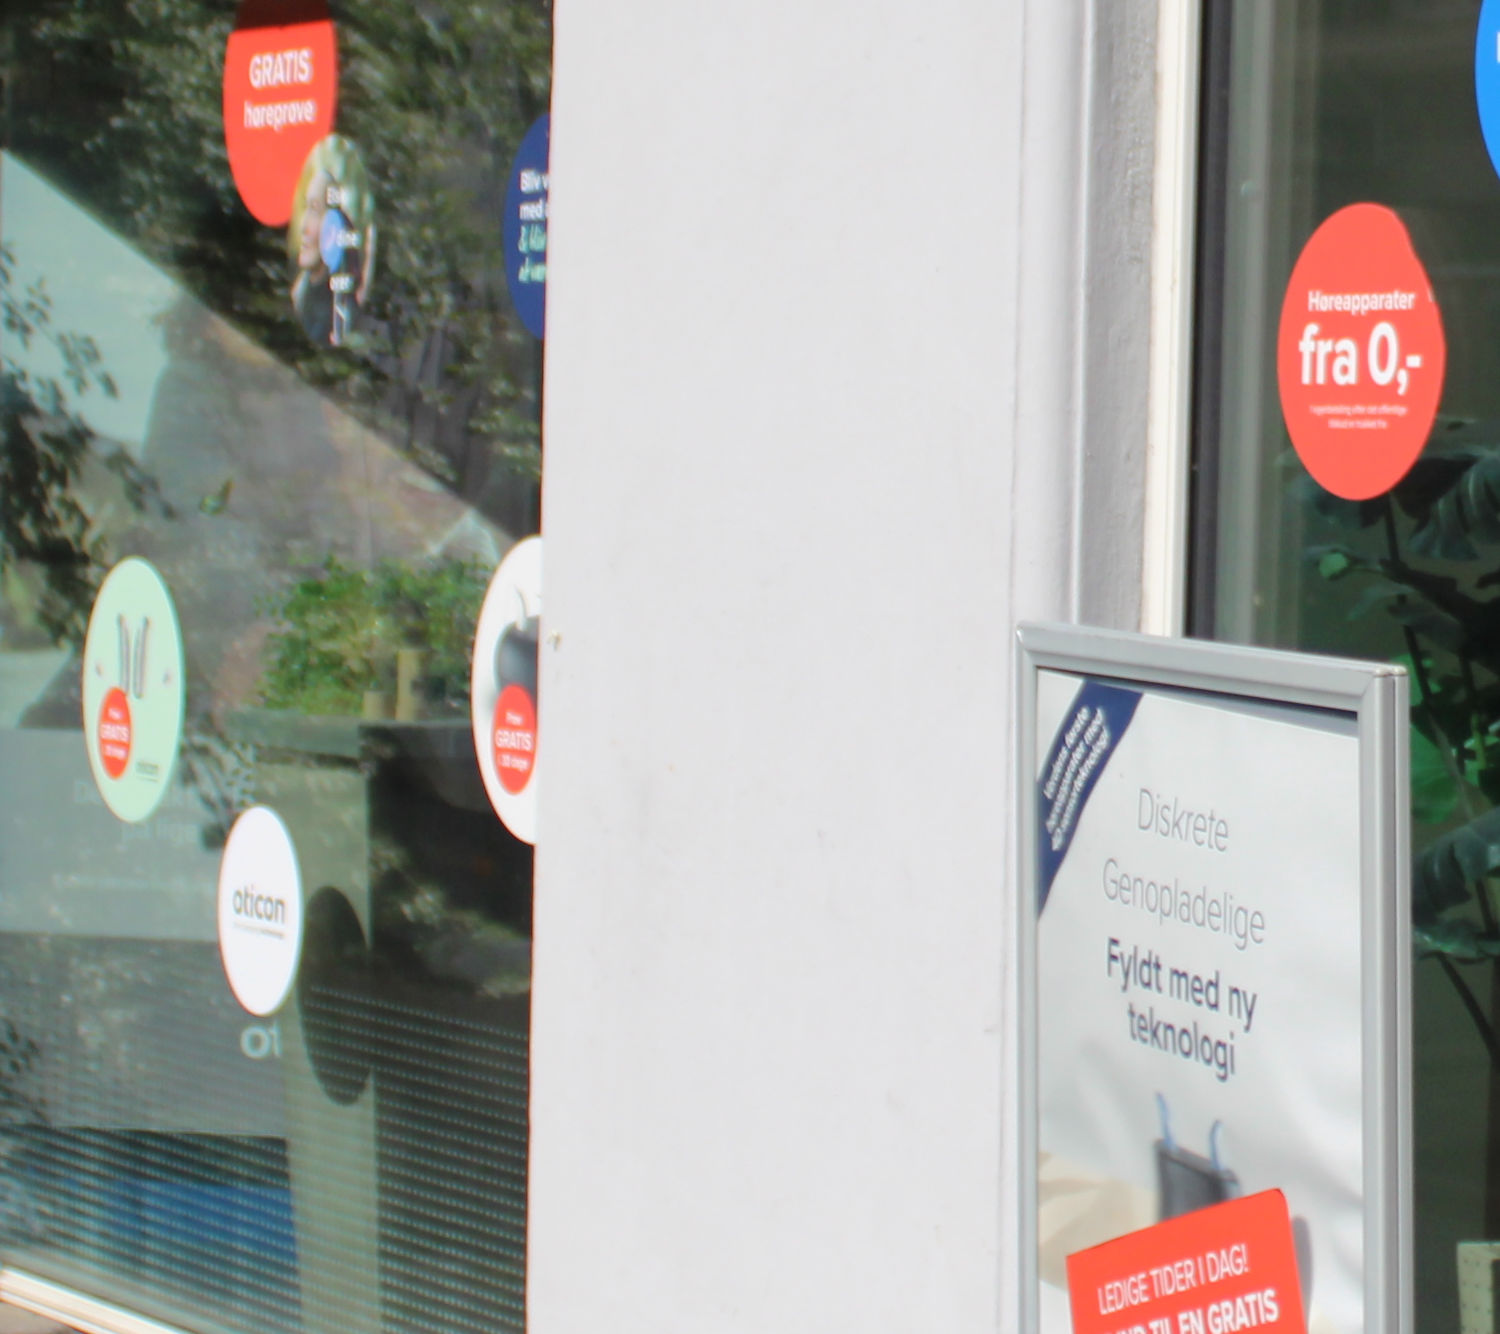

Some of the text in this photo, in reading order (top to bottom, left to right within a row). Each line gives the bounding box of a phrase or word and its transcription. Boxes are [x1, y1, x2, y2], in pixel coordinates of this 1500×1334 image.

[249, 49, 314, 89] GRATIS
[244, 100, 317, 133] høreprøve
[1308, 289, 1416, 317] Høreapparater
[1298, 321, 1423, 397] fra 0,-
[495, 729, 534, 752] GRATIS
[1138, 788, 1229, 852] Diskrete
[232, 884, 287, 925] oticon
[1102, 858, 1266, 951] Genopladelige
[1106, 936, 1258, 1033] Fyldt med ny
[1128, 1002, 1236, 1083] teknologi
[1097, 1243, 1250, 1315] LEDIGE TIDER I DAG!
